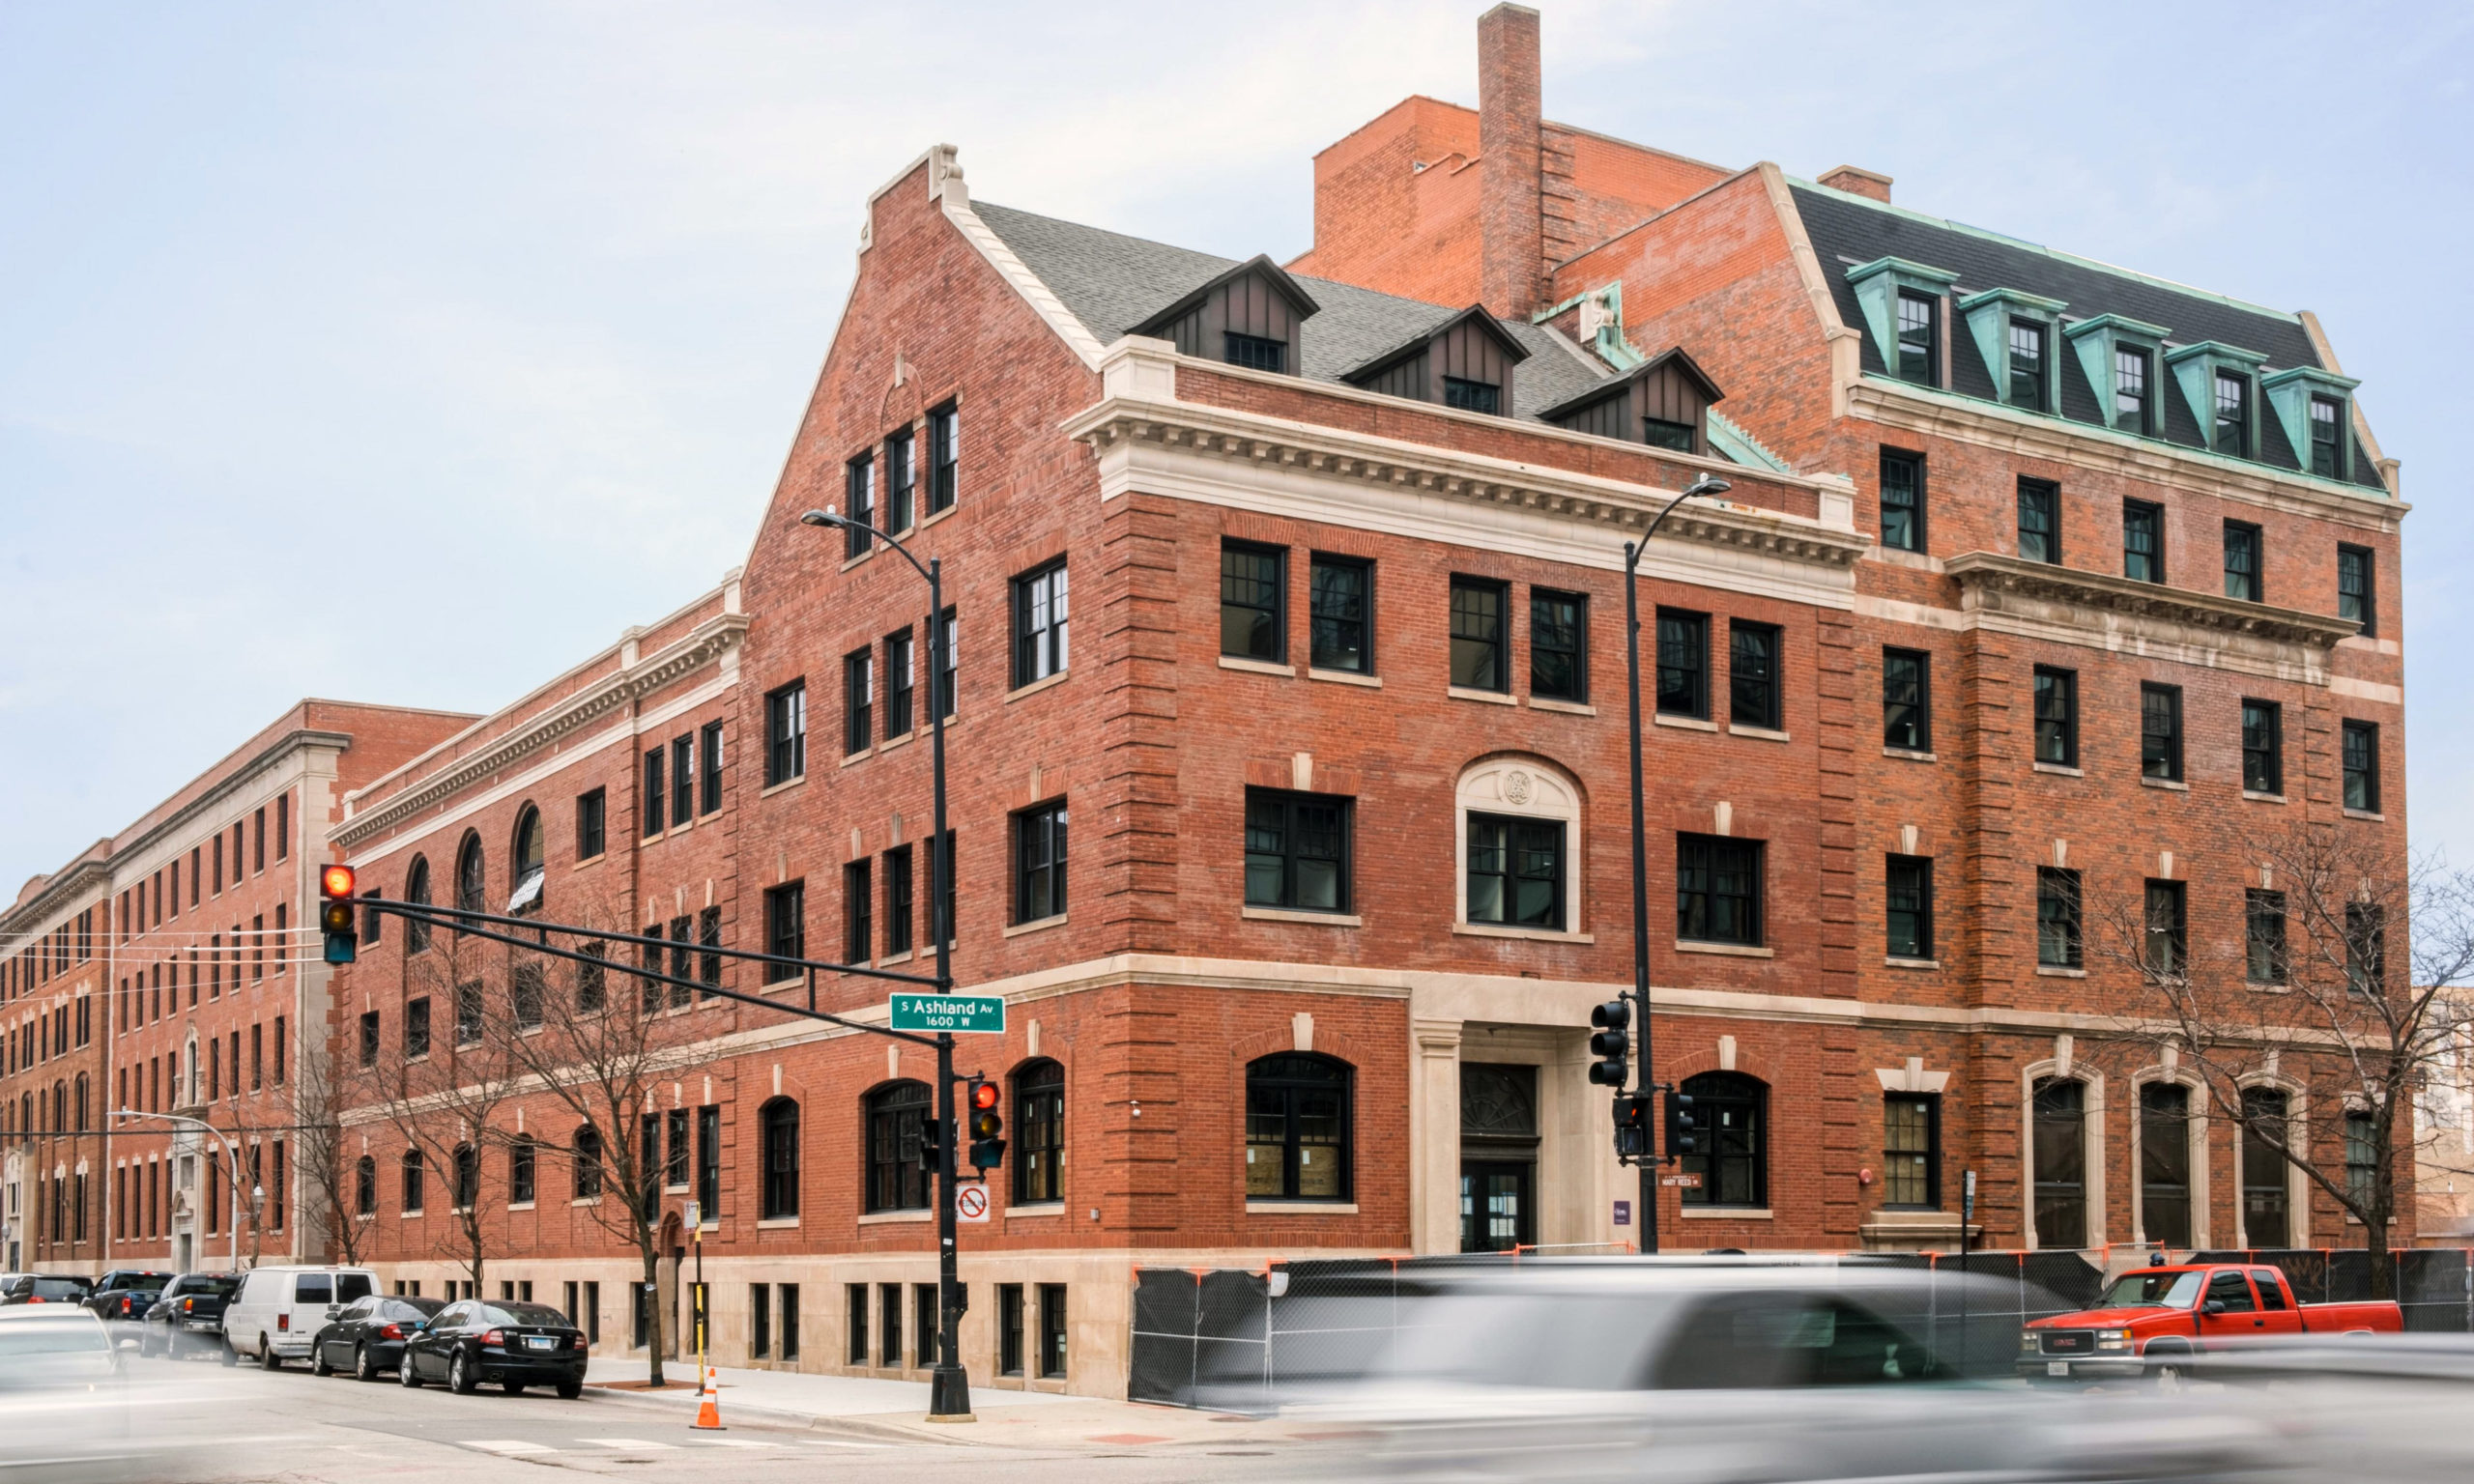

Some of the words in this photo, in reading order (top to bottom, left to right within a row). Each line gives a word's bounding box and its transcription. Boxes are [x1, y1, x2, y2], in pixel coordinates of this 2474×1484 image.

[902, 1001, 908, 1011] S
[913, 999, 976, 1015] Ashland
[980, 1004, 993, 1013] Av
[926, 1016, 954, 1027] 1600
[961, 1017, 970, 1027] W
